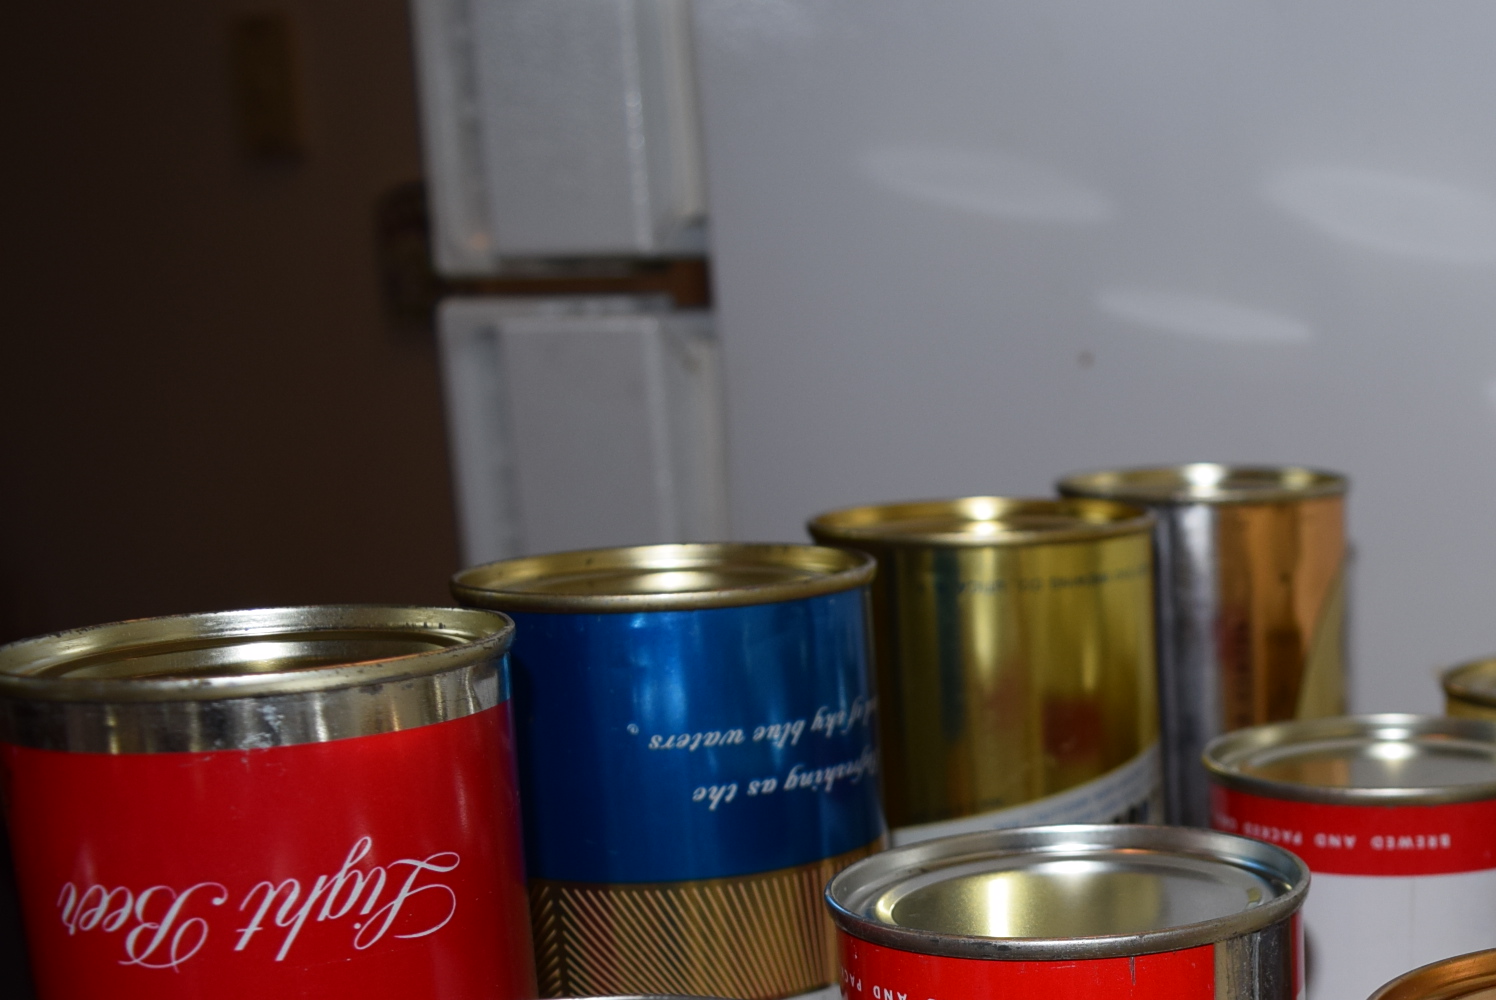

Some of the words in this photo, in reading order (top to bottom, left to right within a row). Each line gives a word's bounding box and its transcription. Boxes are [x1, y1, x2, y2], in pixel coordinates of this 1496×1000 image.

[647, 728, 744, 751] waters
[751, 718, 806, 747] blue
[692, 782, 738, 811] the
[746, 776, 777, 797] as
[1313, 832, 1356, 848] AND
[1370, 833, 1451, 850] BREWED
[233, 836, 460, 962] Light
[56, 881, 229, 973] Beer
